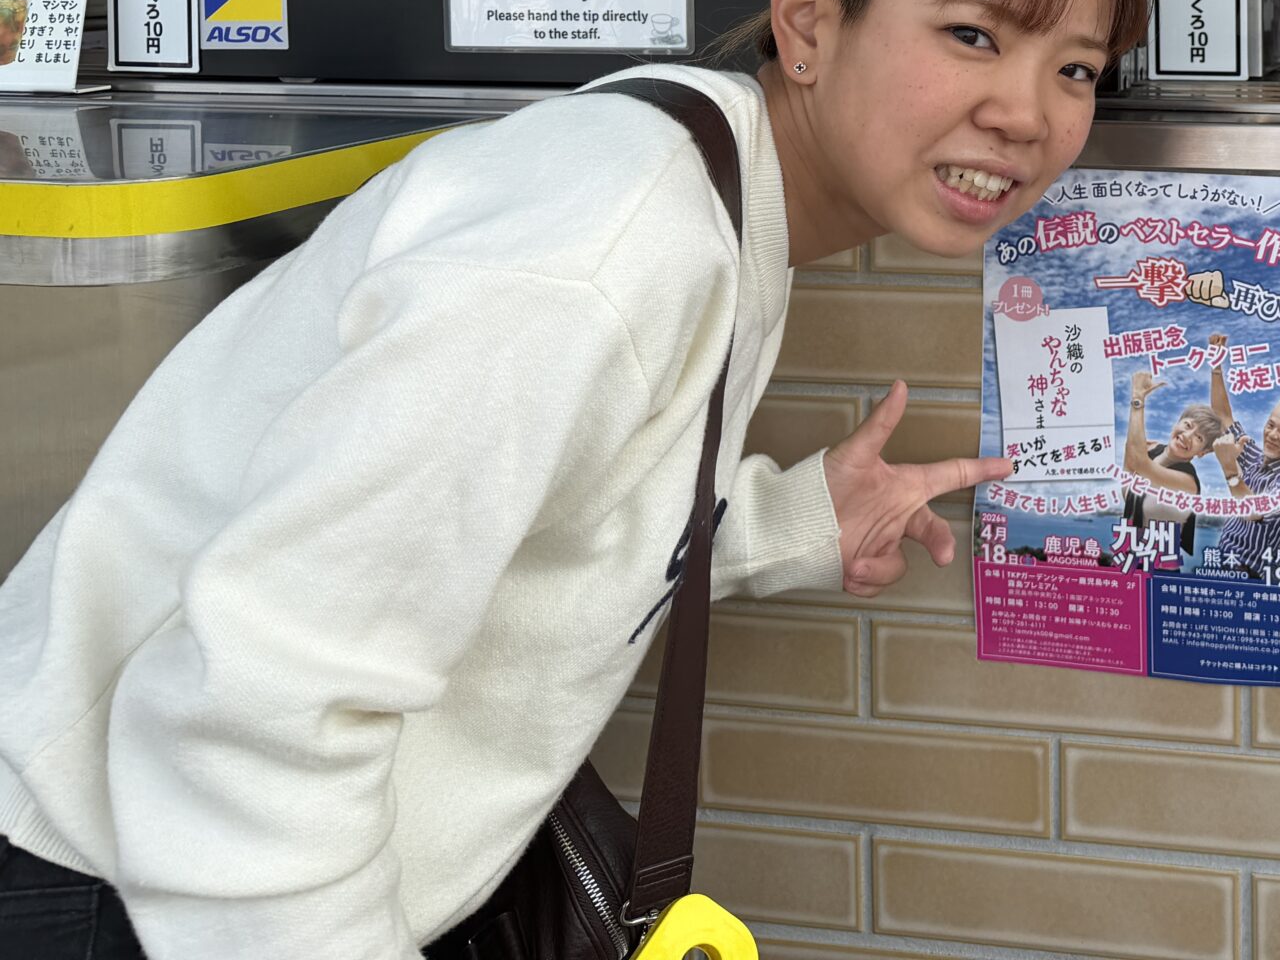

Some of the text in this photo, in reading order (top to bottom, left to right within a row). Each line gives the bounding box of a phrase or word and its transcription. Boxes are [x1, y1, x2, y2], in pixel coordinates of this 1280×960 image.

[42, 1, 77, 10] マシマシ
[487, 10, 648, 24] Please hand the tip directly
[206, 26, 284, 43] ALSOK
[534, 28, 600, 40] to the staff.
[35, 53, 71, 63] ましまし
[1094, 256, 1189, 307] 一撃
[1012, 284, 1032, 299] 1冊
[1065, 324, 1084, 374] 沙織の
[1103, 324, 1189, 359] 出版記念
[1150, 344, 1270, 377] トークショー
[1042, 335, 1070, 417] やんちゃな
[1028, 374, 1048, 430] 神さま
[1007, 436, 1046, 459] 笑いが
[981, 525, 1007, 541] 4月
[1112, 517, 1176, 556] 九州
[1044, 535, 1100, 556] 鹿児島
[1047, 556, 1098, 567] KAGOSHIMA
[1203, 548, 1241, 568] 熊本
[1195, 568, 1248, 579] KUMAMOTO
[1209, 610, 1233, 618] 13:00
